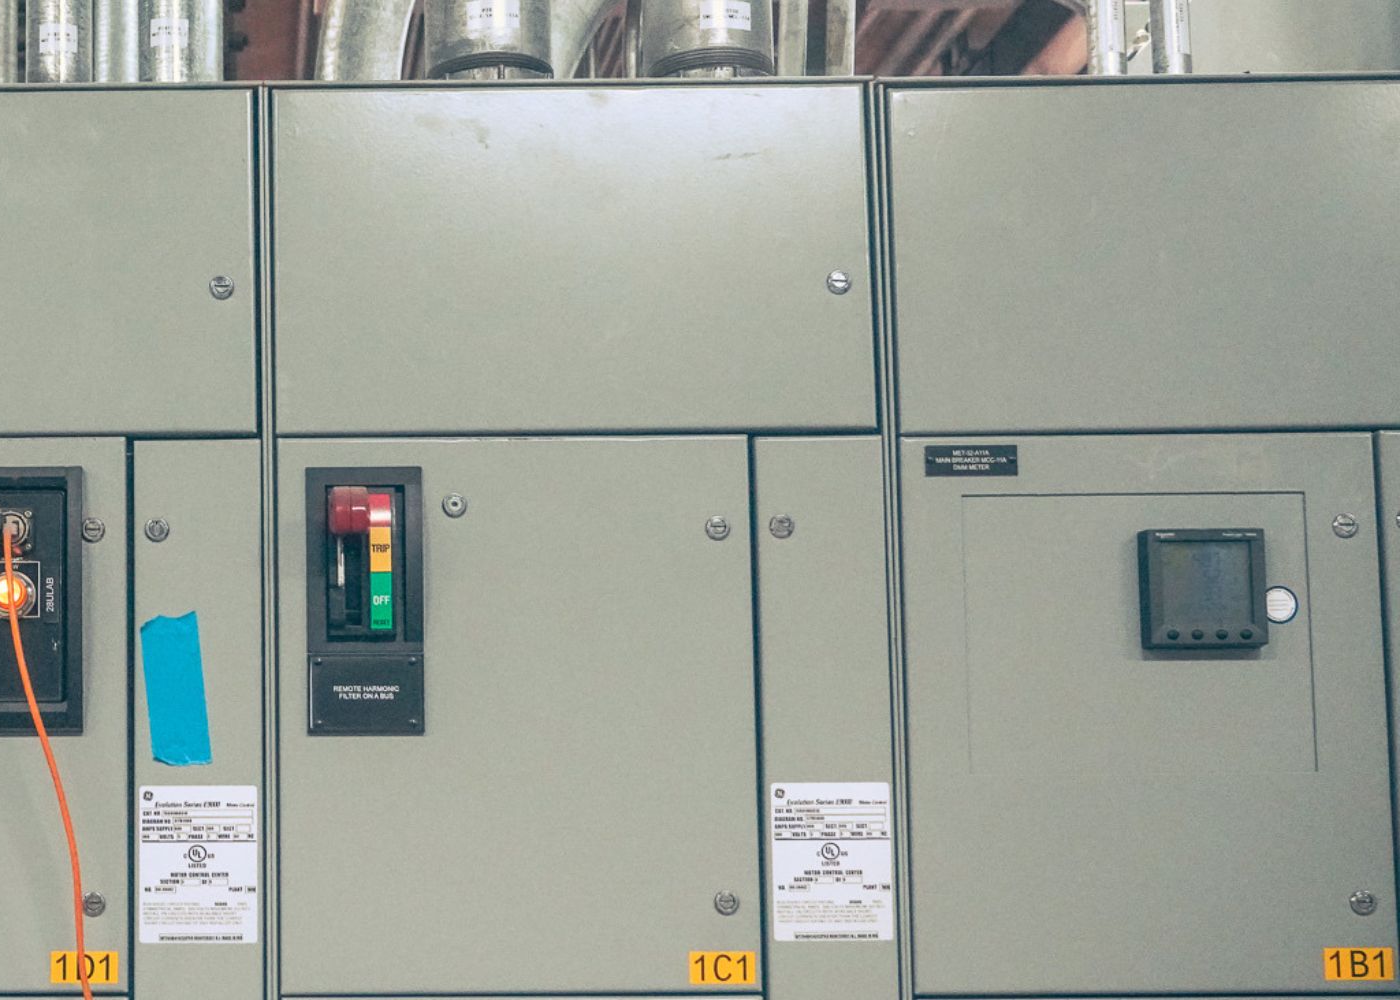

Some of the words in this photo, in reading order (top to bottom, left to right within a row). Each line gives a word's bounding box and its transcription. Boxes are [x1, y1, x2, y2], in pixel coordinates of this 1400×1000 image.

[371, 544, 390, 553] TRIP
[373, 595, 391, 606] OFF
[339, 692, 362, 700] FILTER
[362, 692, 374, 700] ON
[380, 692, 395, 700] BUS
[56, 953, 110, 981] 1D1
[694, 954, 747, 982] 1C1
[1329, 950, 1385, 978] 1B1
